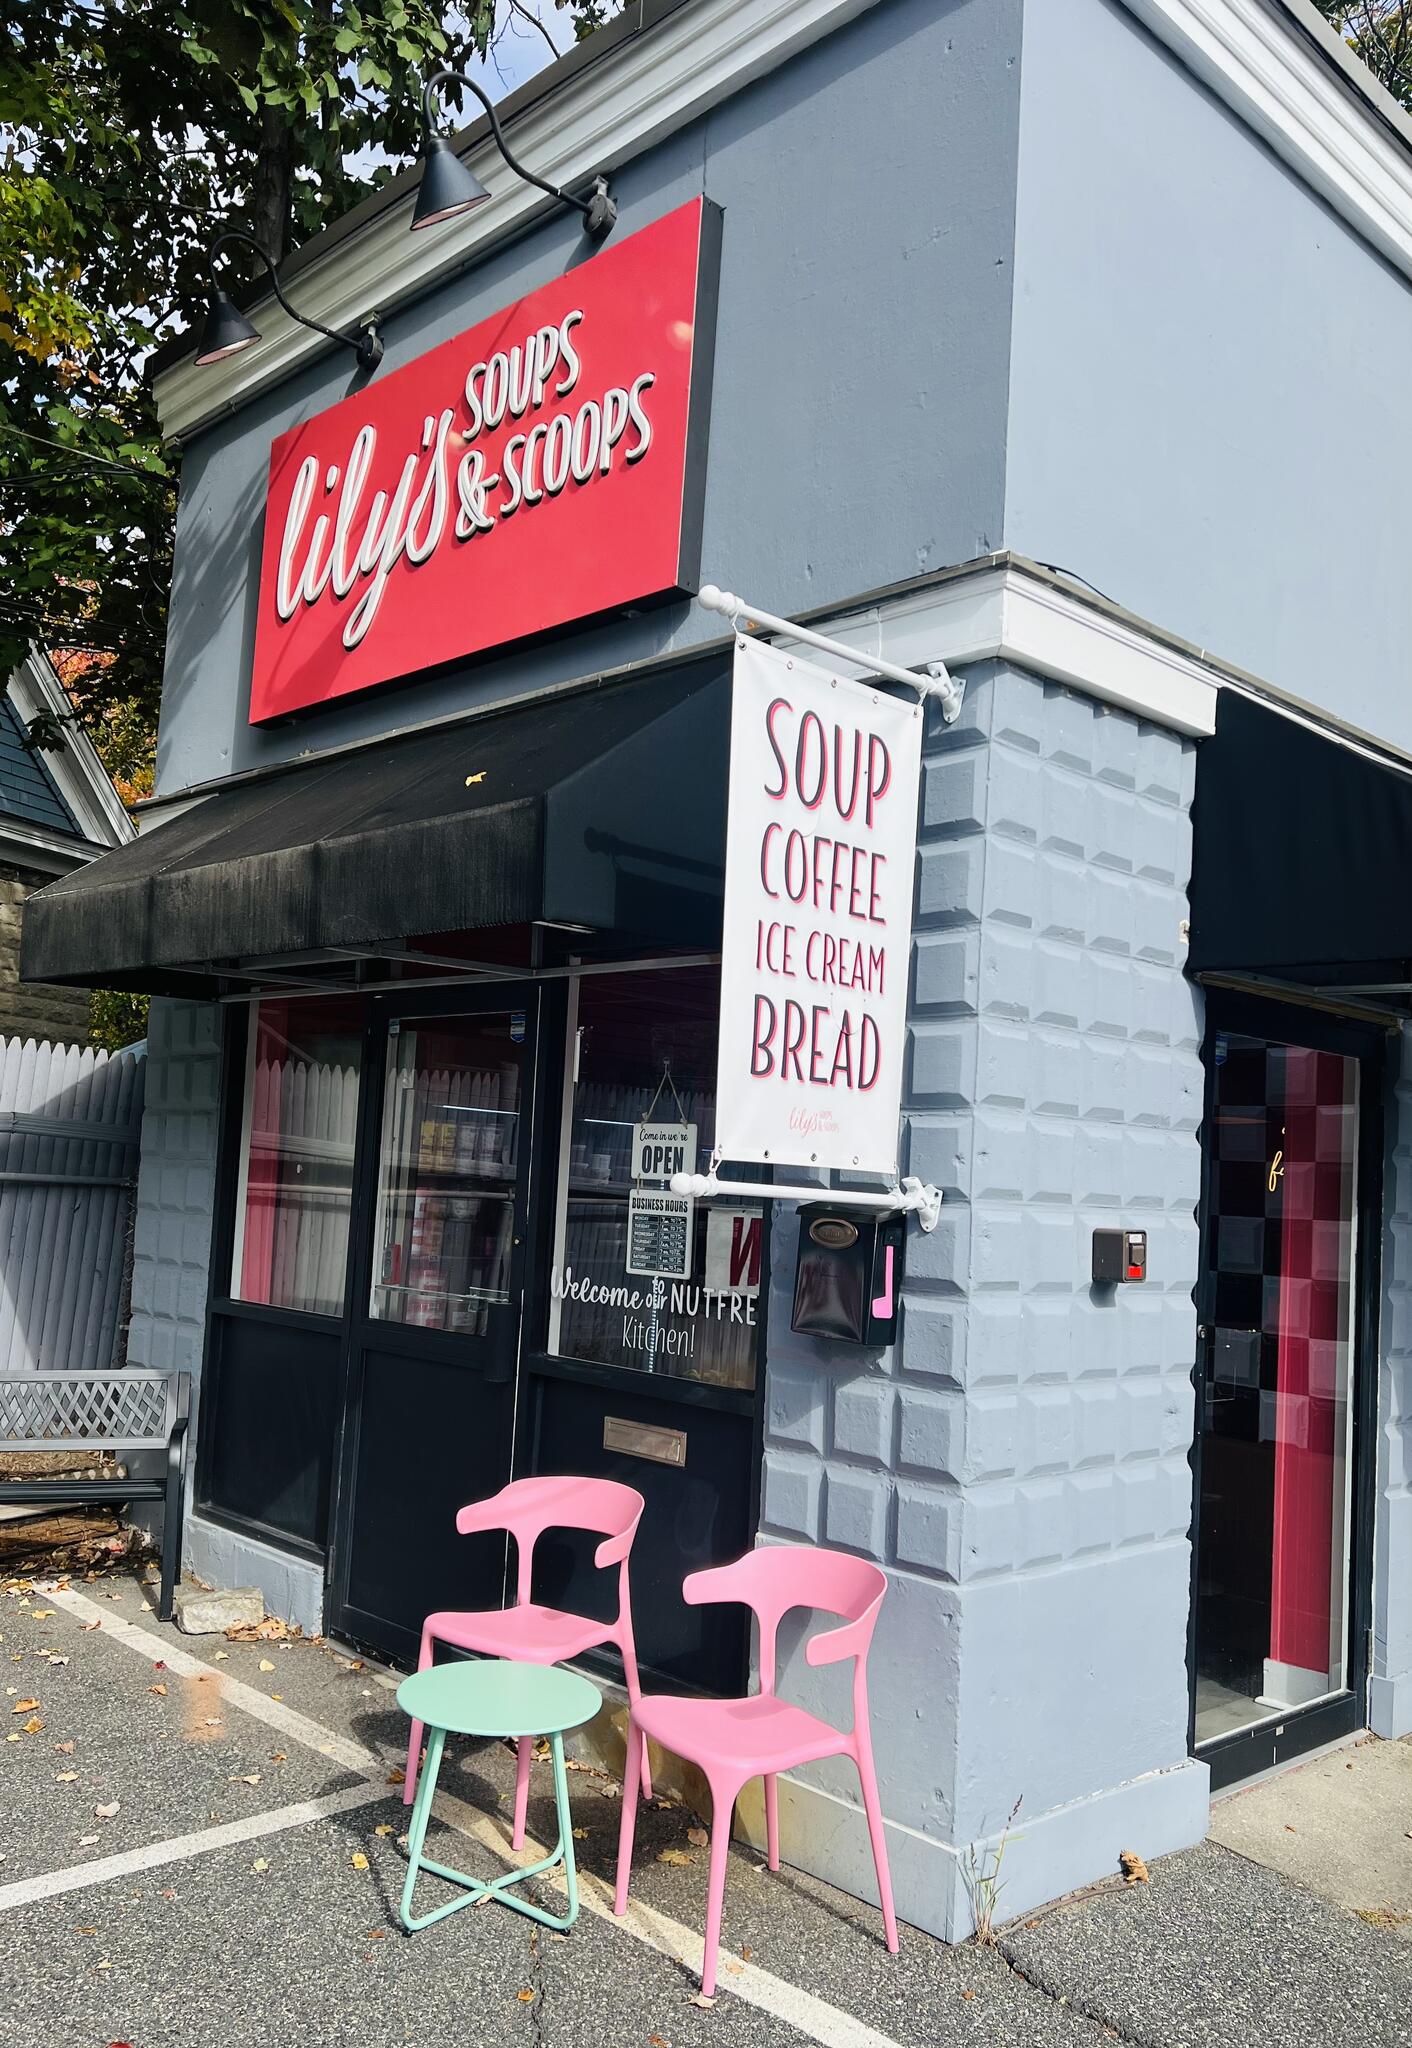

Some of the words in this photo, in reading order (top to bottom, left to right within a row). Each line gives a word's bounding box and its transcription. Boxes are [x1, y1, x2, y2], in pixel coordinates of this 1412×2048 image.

[461, 310, 583, 440] SOUPS
[455, 450, 499, 538] &
[500, 373, 655, 513] SCOOPS
[277, 408, 454, 647] lily's
[764, 697, 891, 828] SOUP
[760, 822, 887, 925] COFFEE
[755, 919, 796, 978] ICE
[806, 930, 886, 996] CREAM
[750, 993, 881, 1091] BREAD
[640, 1128, 658, 1141] Come
[659, 1131, 667, 1141] in
[641, 1145, 684, 1174] OPEN
[632, 1197, 664, 1211] BUSINESS
[665, 1199, 688, 1213] HOURS
[550, 1266, 645, 1310] Welcome
[645, 1292, 668, 1310] our
[652, 1275, 665, 1295] to
[622, 1315, 695, 1358] Kitchen!
